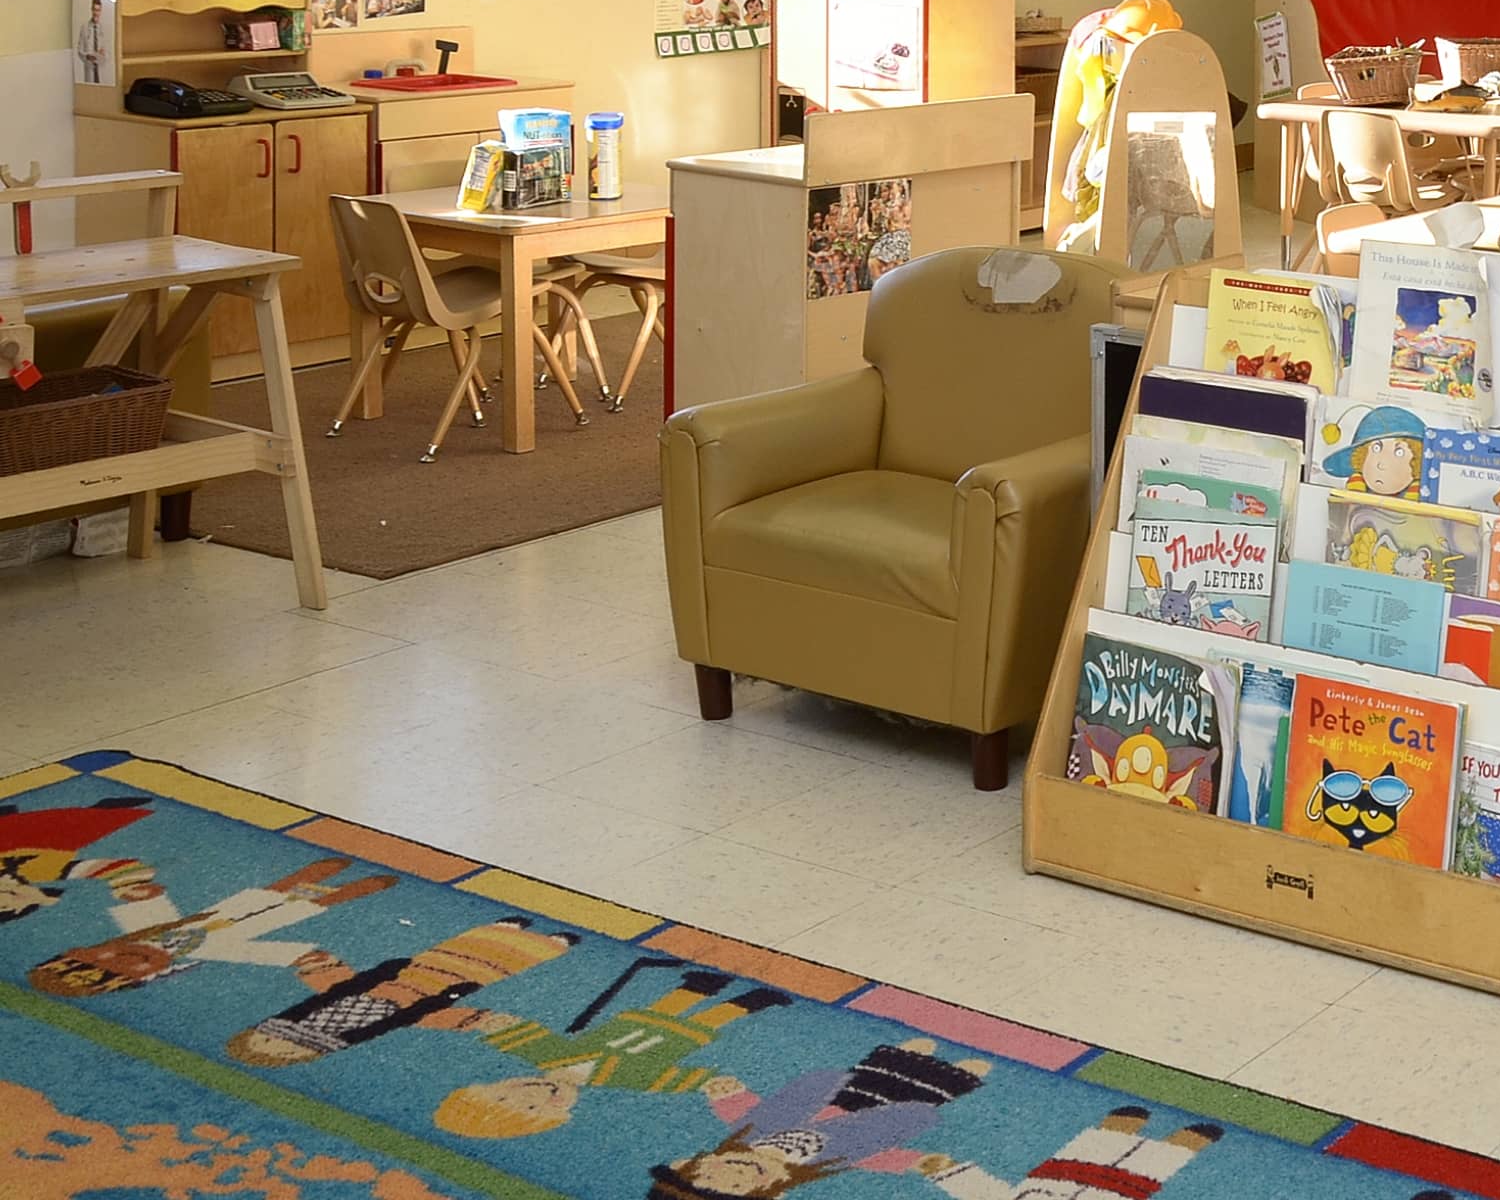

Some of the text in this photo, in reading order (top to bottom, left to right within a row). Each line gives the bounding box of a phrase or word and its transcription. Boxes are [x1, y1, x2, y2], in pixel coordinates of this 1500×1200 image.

[1371, 251, 1393, 263] This
[1396, 255, 1429, 268] House
[1433, 258, 1442, 269] Is
[1233, 298, 1318, 320] When I Feel Angry
[1141, 525, 1168, 543] TEN
[1165, 528, 1267, 572] Thank-You
[1203, 570, 1264, 590] LETTERS
[1099, 649, 1138, 679] Billy
[1084, 661, 1213, 743] DAYMARE
[1326, 688, 1364, 705] Kimberly
[1367, 697, 1373, 707] &
[1376, 699, 1401, 712] James
[1310, 697, 1436, 753] Pete the Cat
[1307, 733, 1326, 747] and
[1348, 739, 1377, 757] Magic
[1382, 743, 1433, 771] Sunglasses
[1461, 756, 1475, 774] IF
